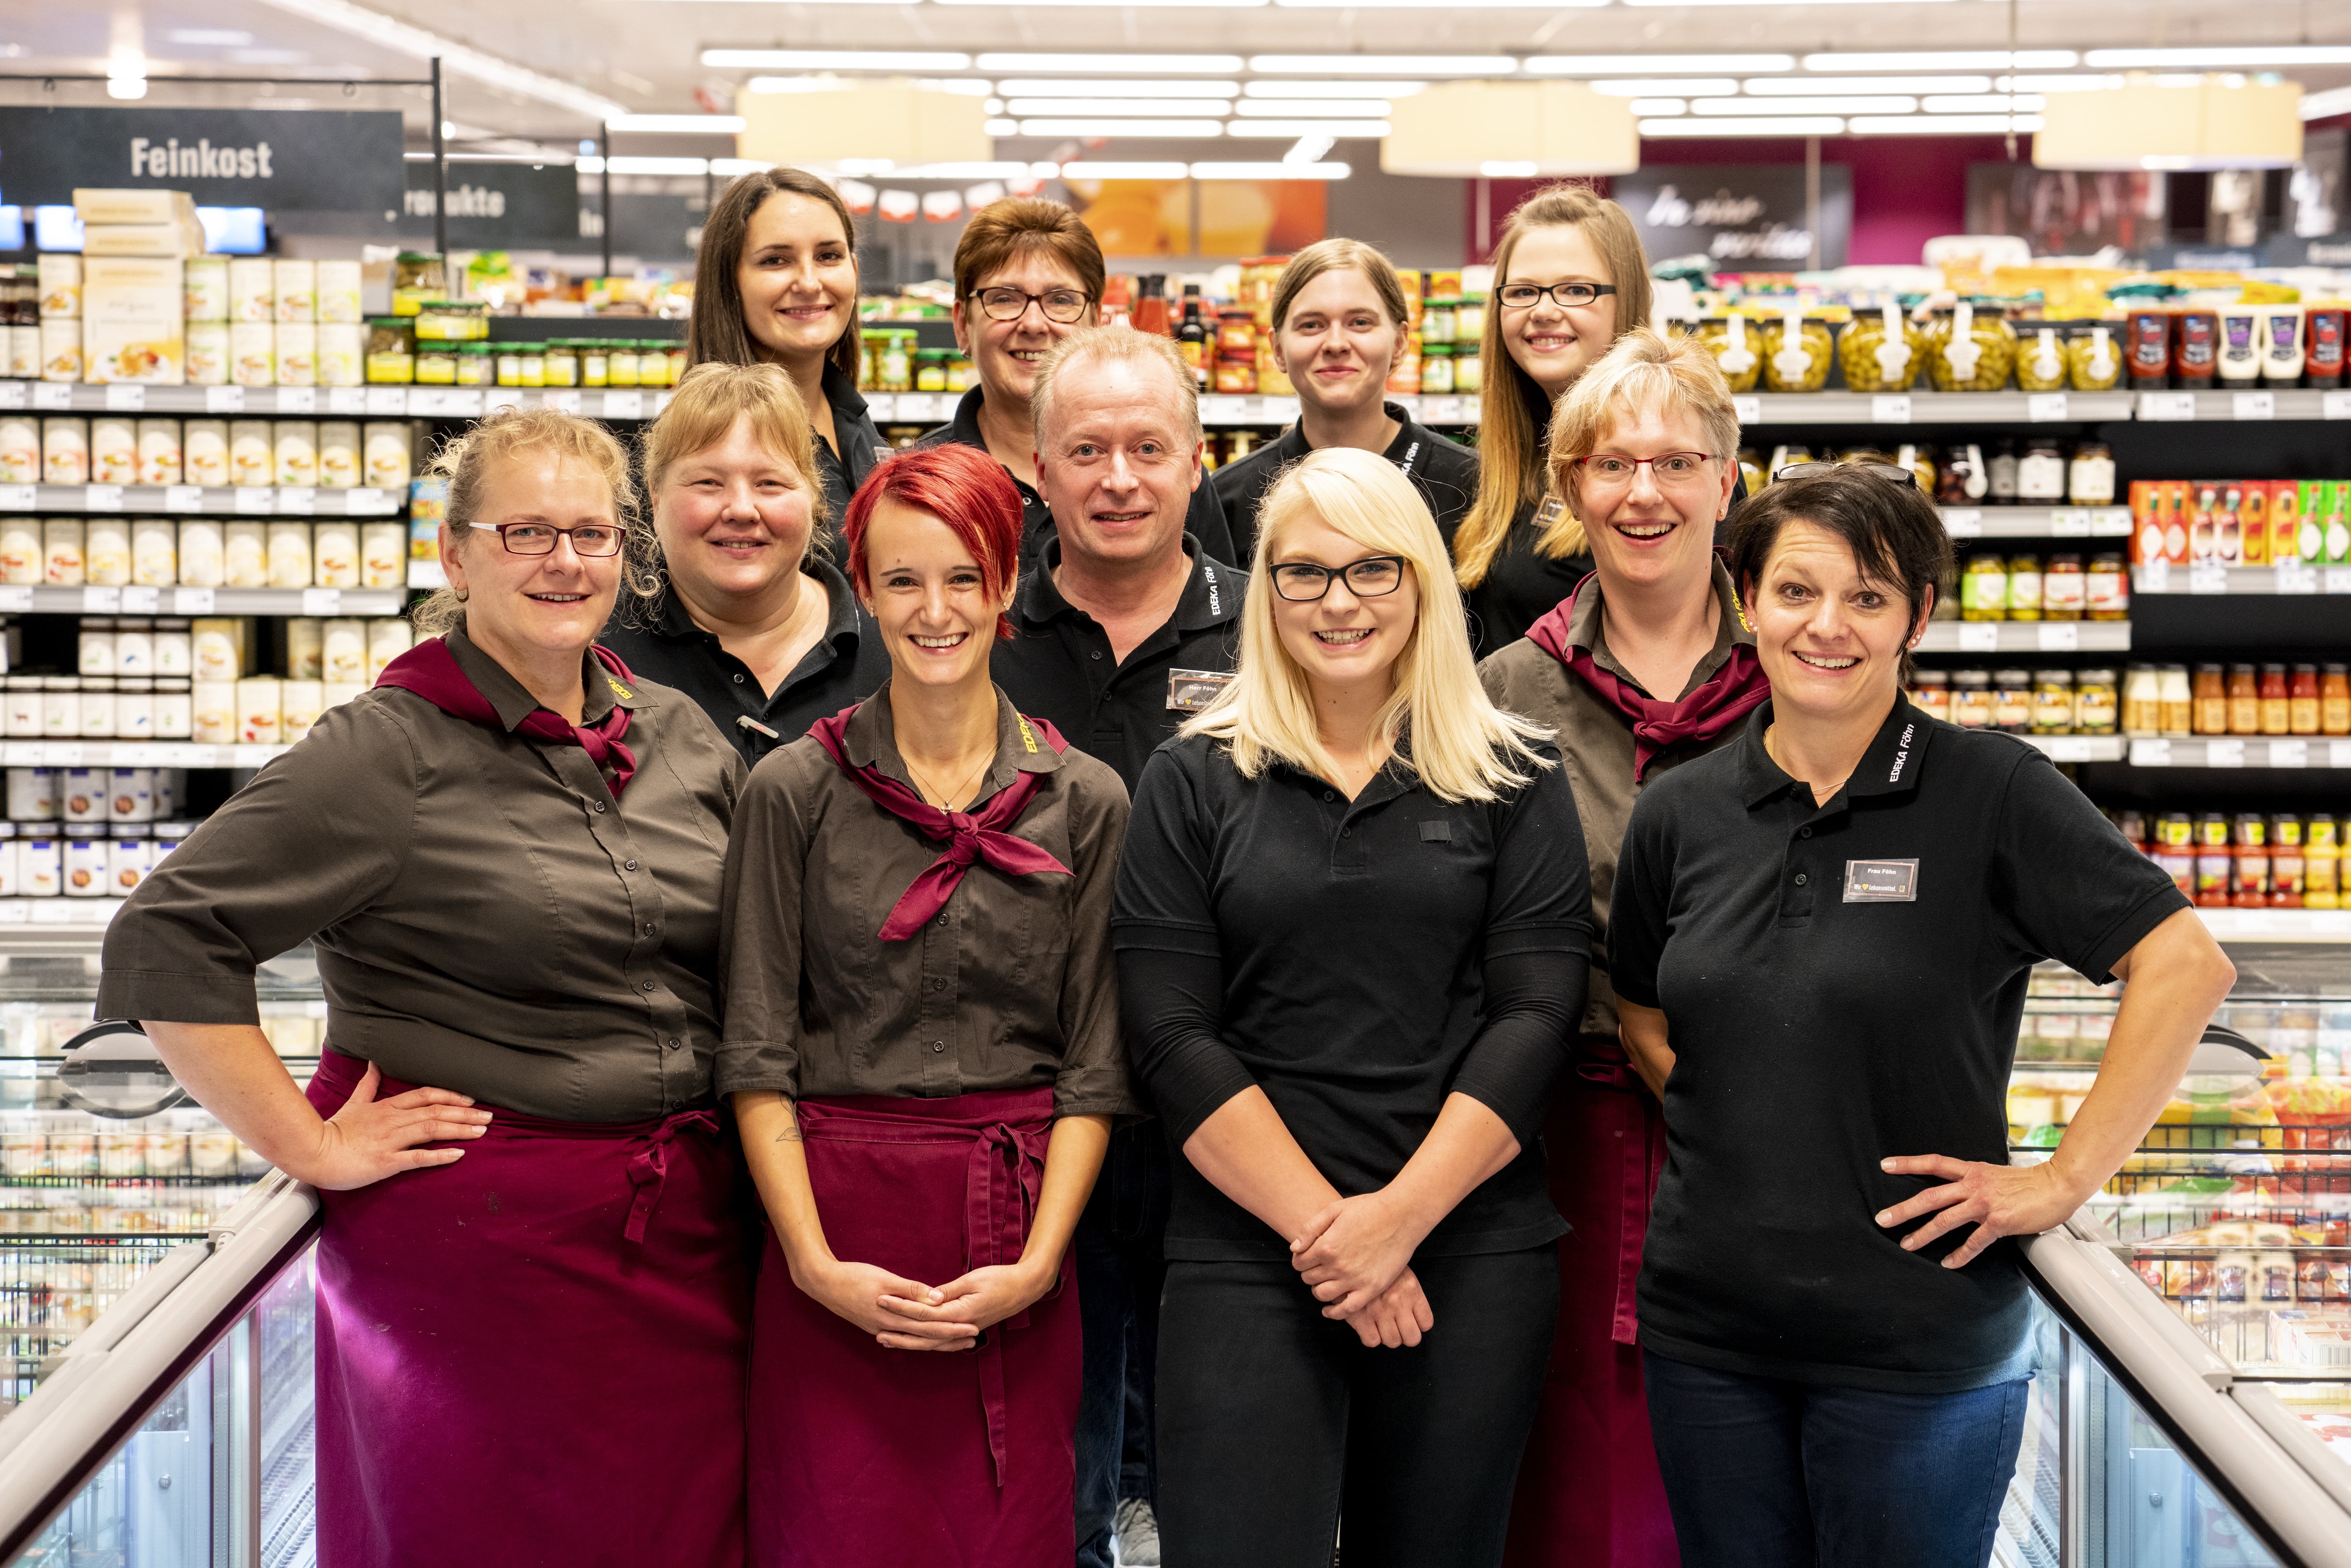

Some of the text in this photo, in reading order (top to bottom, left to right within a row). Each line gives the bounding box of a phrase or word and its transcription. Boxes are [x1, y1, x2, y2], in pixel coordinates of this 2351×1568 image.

[131, 138, 273, 178] Feinkost
[1205, 567, 1221, 615] EDEKA Föhn
[1889, 724, 1915, 782] EDEKA Föhn
